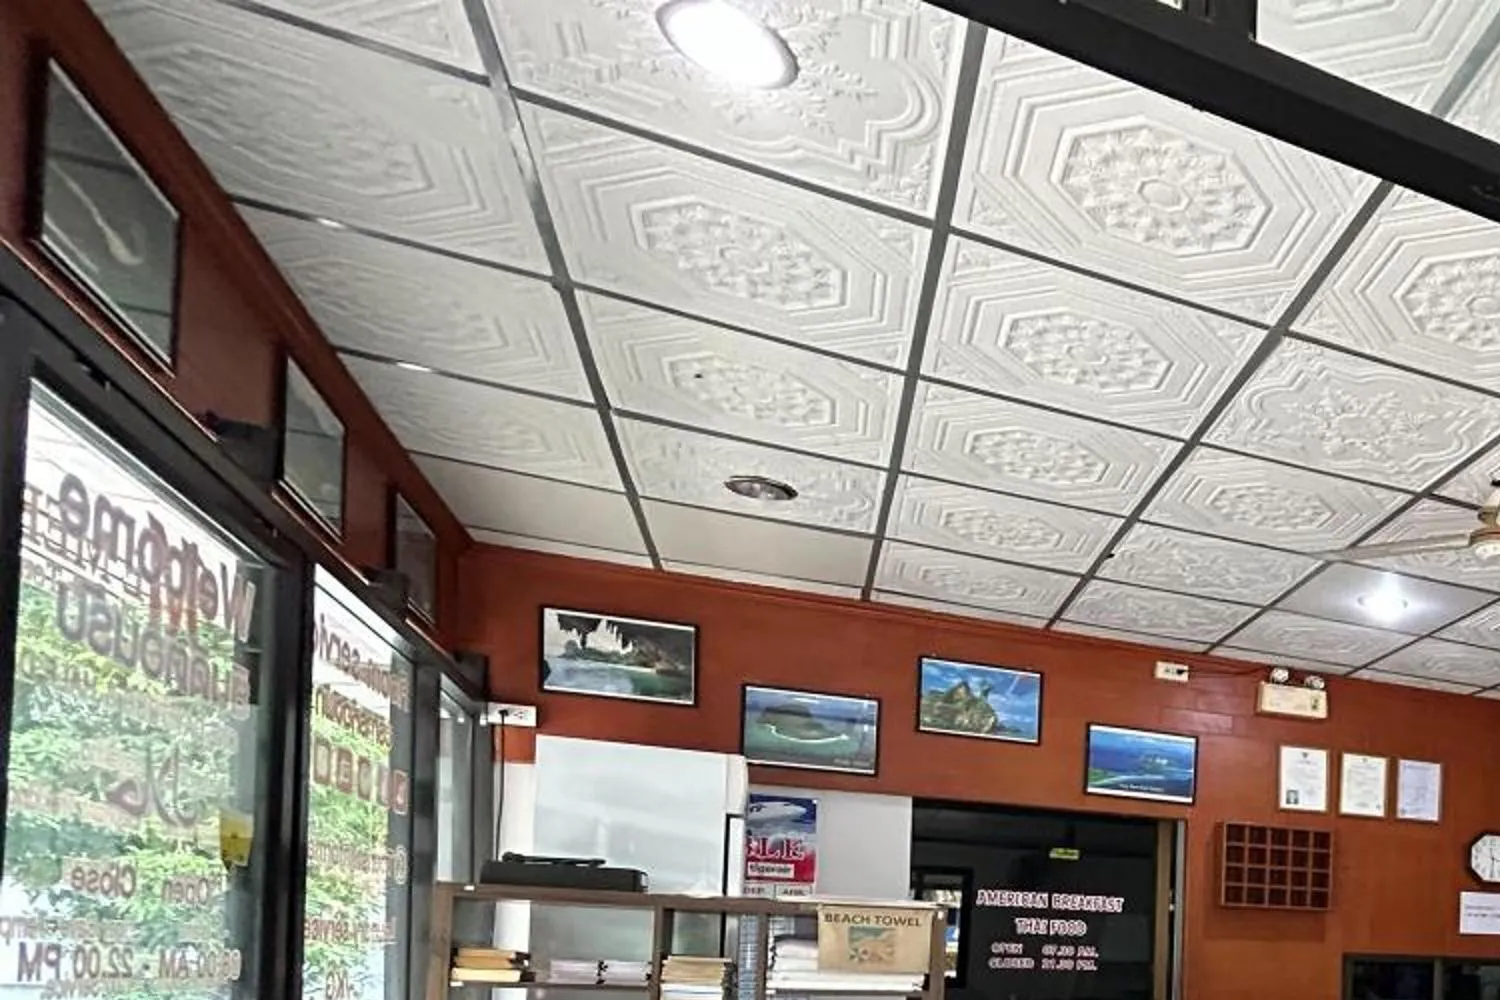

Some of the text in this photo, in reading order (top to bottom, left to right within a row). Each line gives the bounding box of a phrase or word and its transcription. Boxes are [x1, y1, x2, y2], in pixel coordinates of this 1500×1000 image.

[976, 889, 1124, 913] AMERICAN BREAKFAST
[824, 912, 922, 928] BEACH TOWEL
[1015, 918, 1088, 937] THAI FOOD
